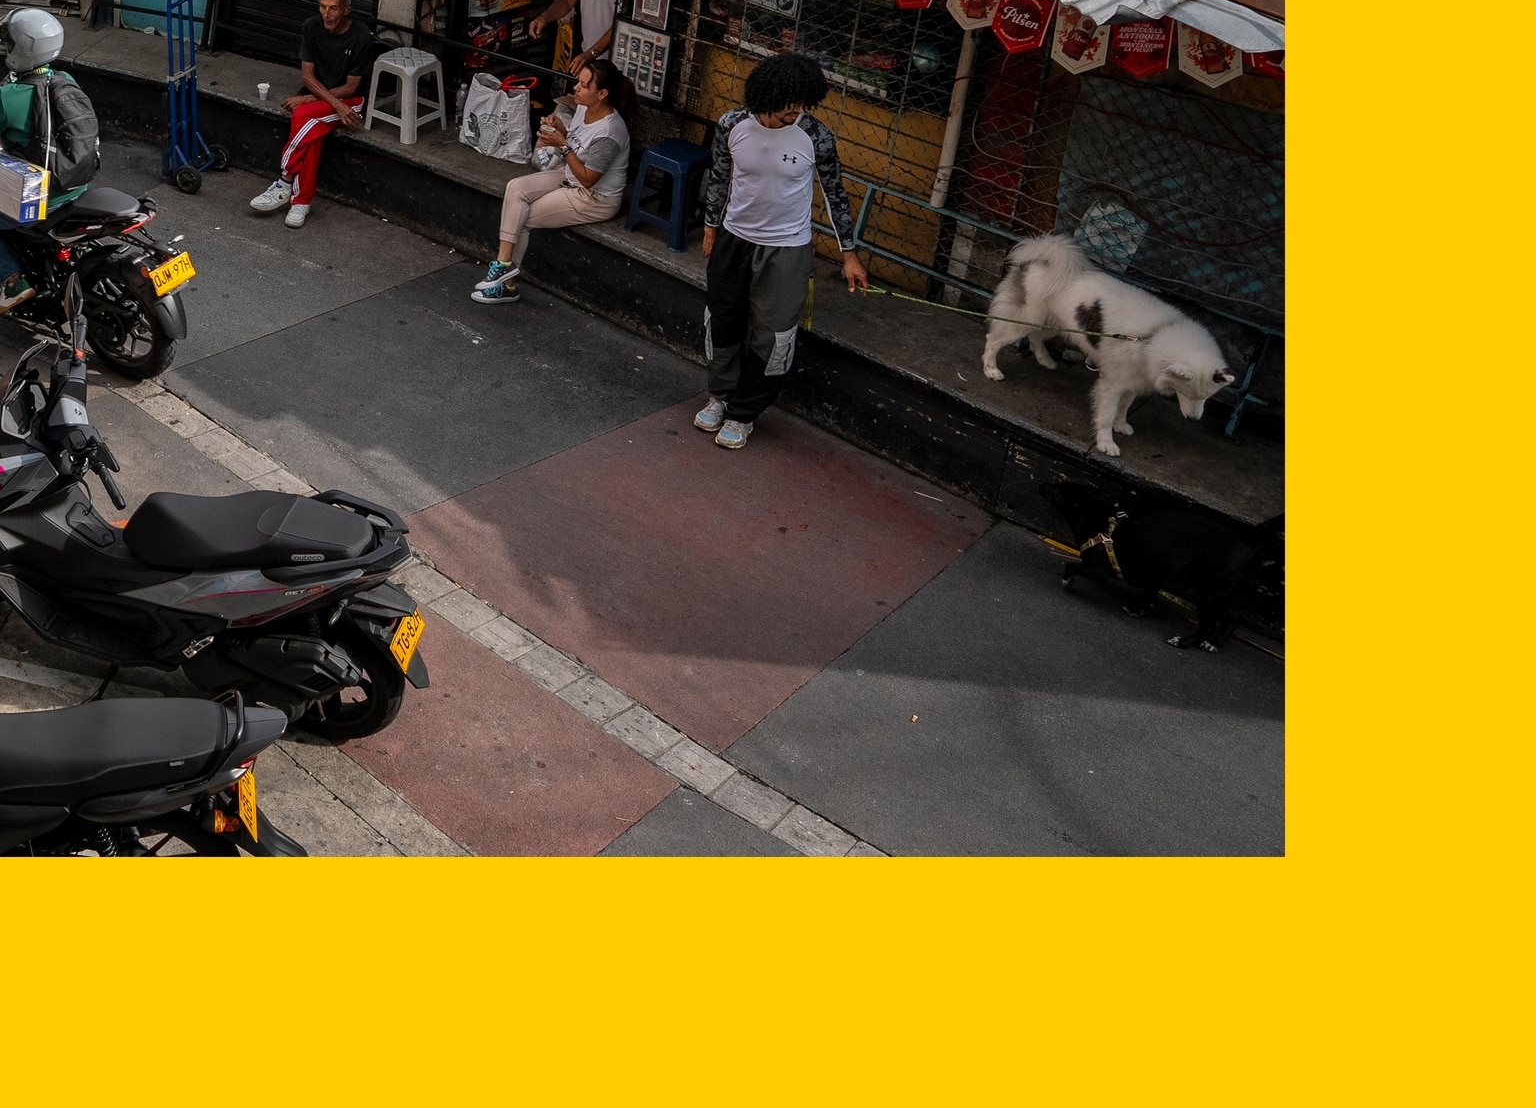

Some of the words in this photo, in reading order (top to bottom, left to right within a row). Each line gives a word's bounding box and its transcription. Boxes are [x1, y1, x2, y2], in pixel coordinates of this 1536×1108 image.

[1000, 6, 1039, 30] Pilsen
[1116, 33, 1166, 41] ANTIOQUIA
[1119, 26, 1165, 34] MONTAÑAS
[1118, 41, 1164, 49] MONTAÑERO
[154, 267, 172, 288] QJM
[173, 257, 191, 277] 97H
[394, 632, 410, 664] LTG
[406, 609, 422, 637] 82H
